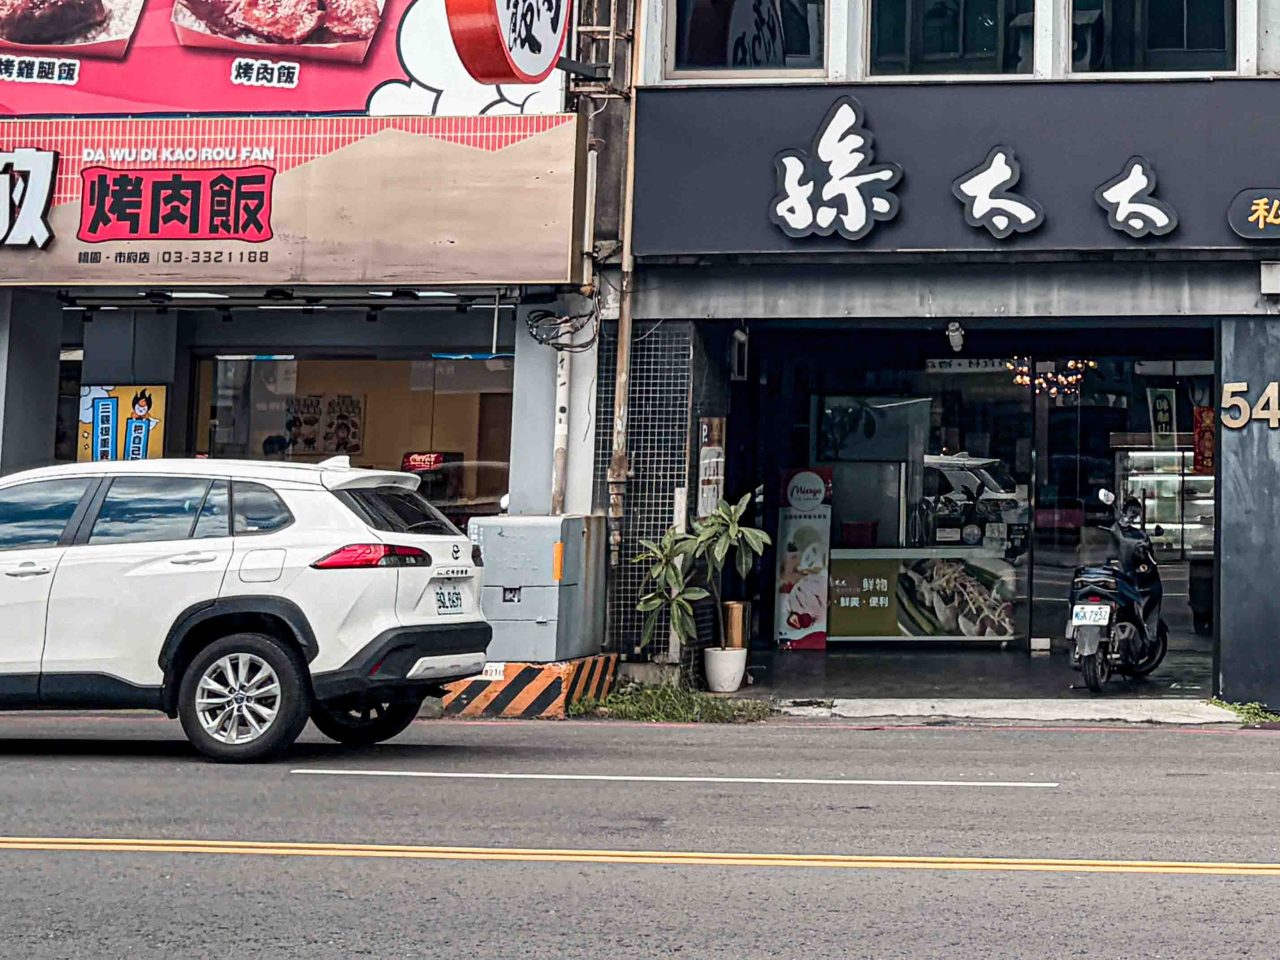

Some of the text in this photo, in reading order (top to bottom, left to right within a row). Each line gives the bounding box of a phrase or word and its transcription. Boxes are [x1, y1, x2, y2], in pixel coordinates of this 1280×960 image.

[235, 61, 296, 84] 烤肉飯
[83, 147, 275, 162] DA WU DI KAO ROU FAN
[88, 174, 266, 234] 烤肉飯
